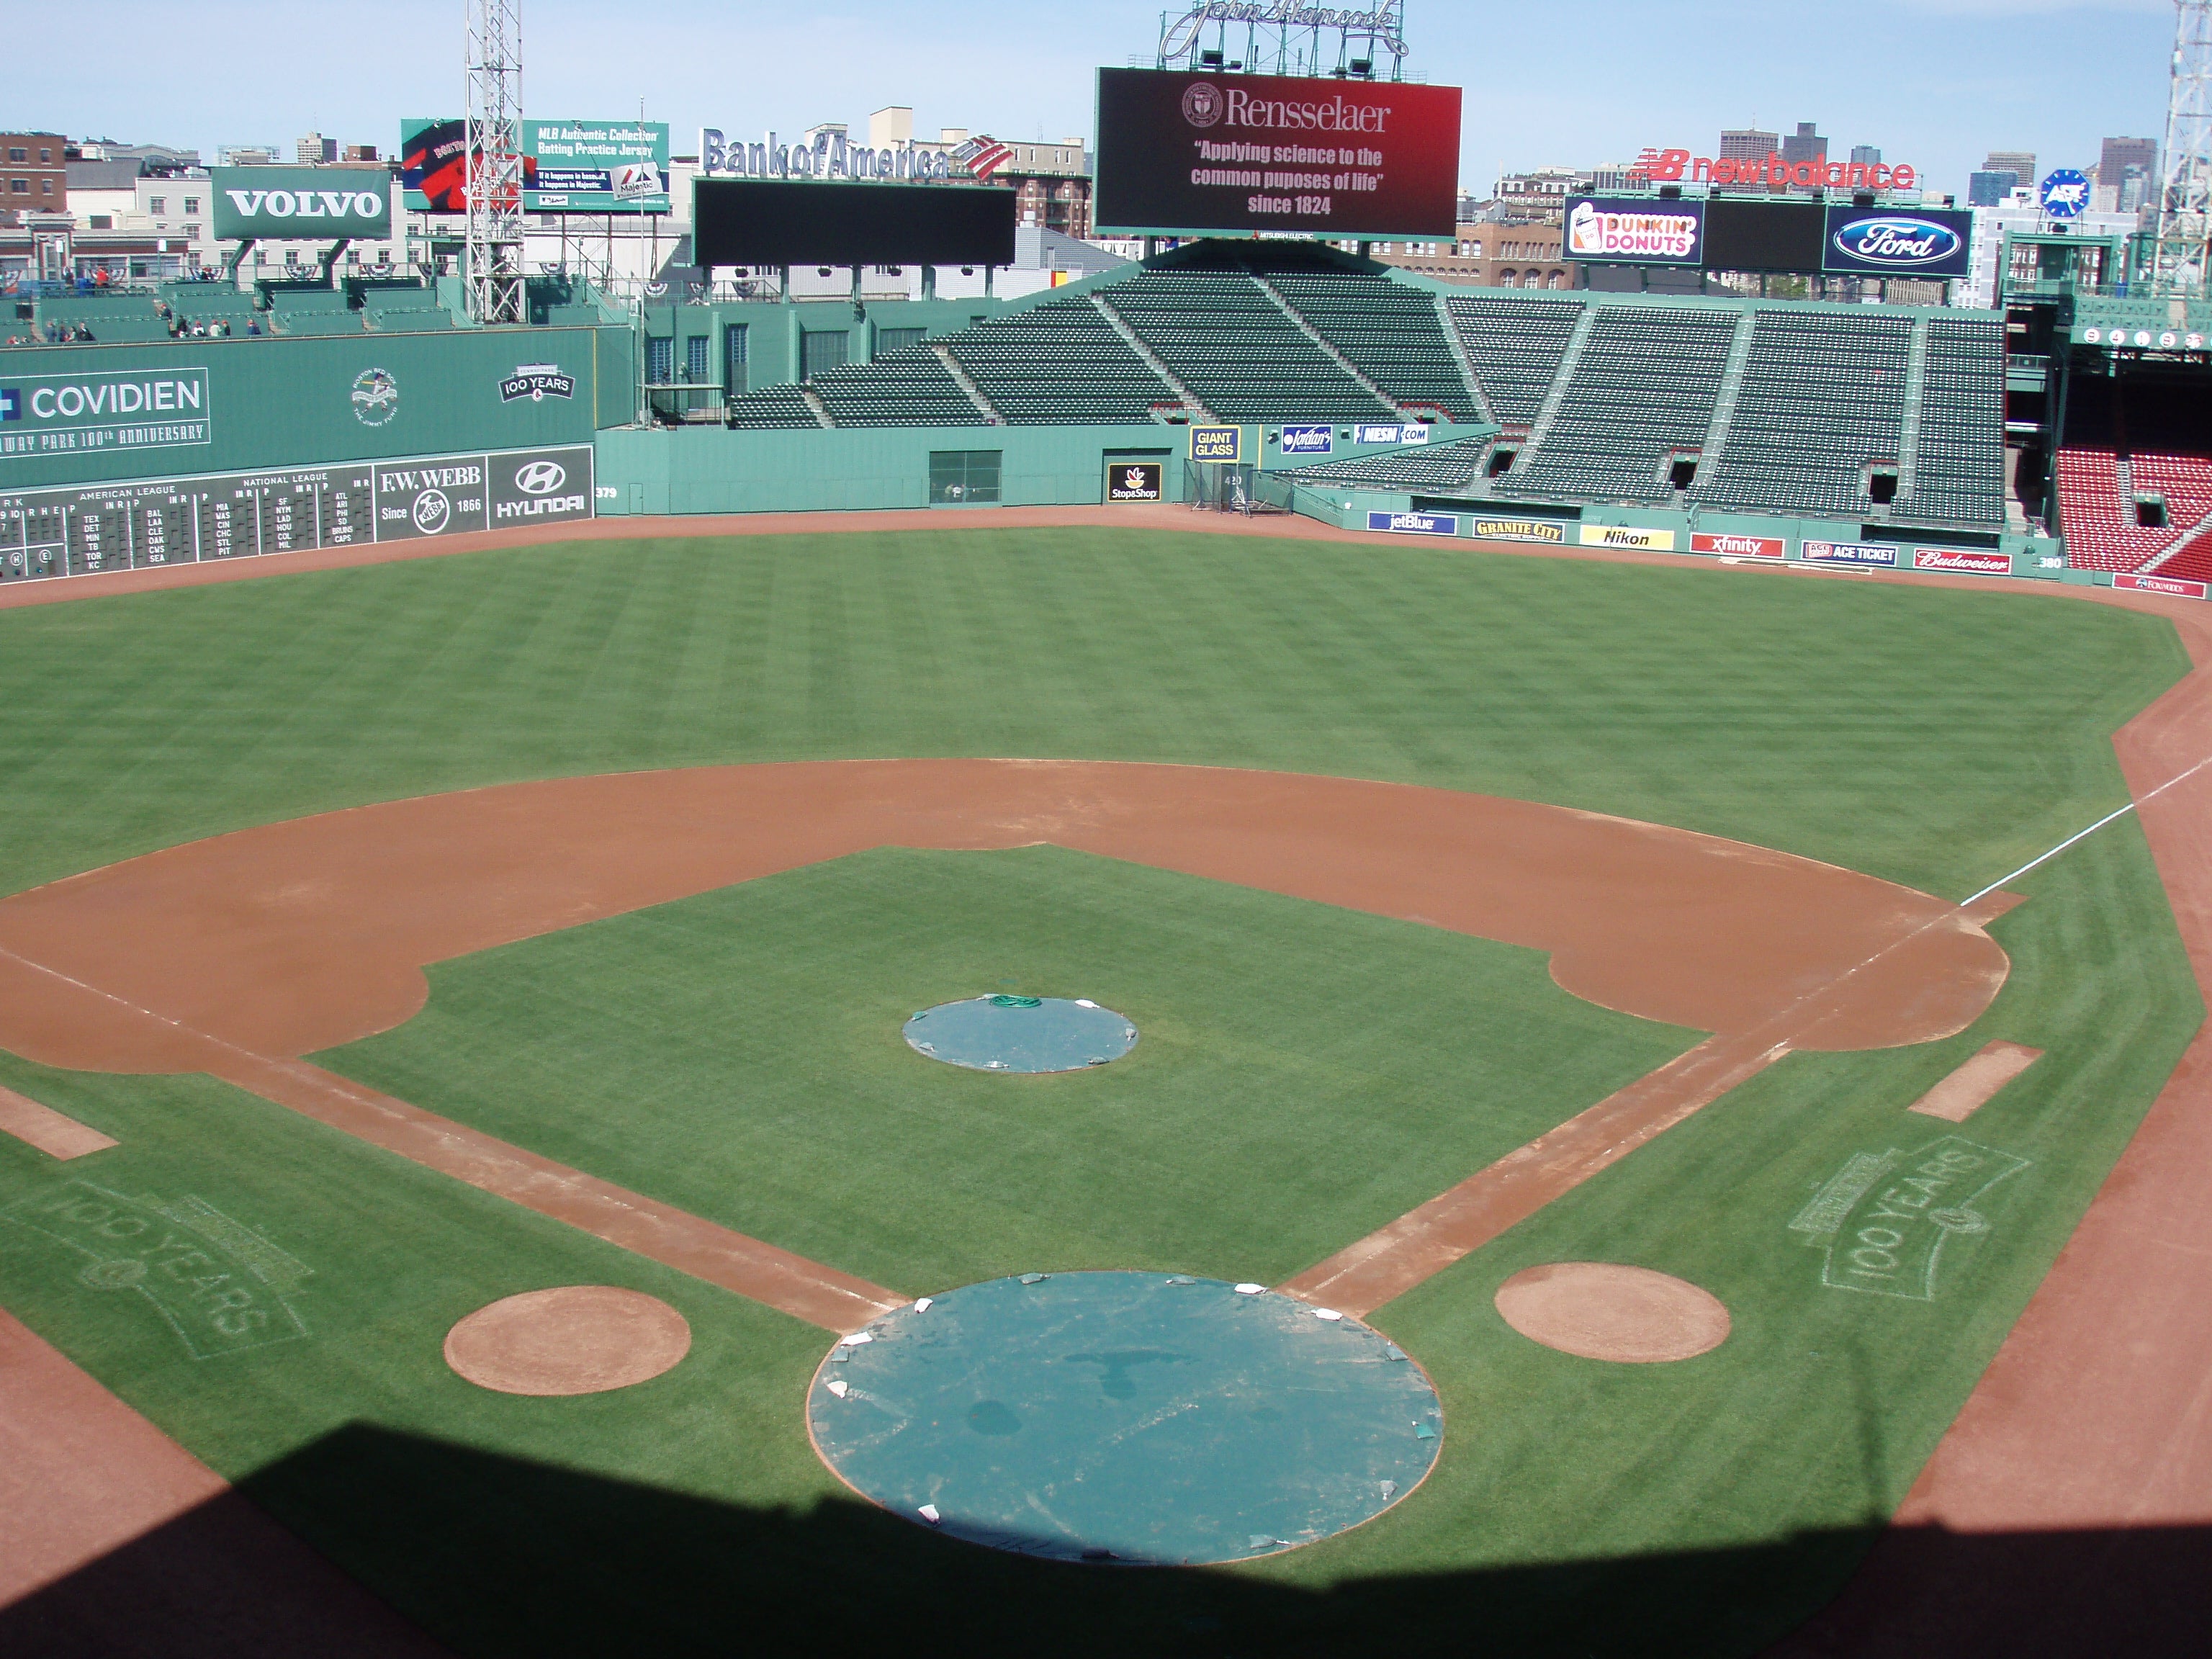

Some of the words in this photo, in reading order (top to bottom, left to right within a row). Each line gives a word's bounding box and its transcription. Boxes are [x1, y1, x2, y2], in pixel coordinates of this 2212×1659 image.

[1162, 0, 1262, 58] John
[1225, 89, 1391, 132] Rensselaer
[538, 127, 559, 140] MLB
[561, 127, 607, 140] Authentic
[609, 128, 657, 141] Collection
[538, 142, 573, 156] Batting
[576, 143, 616, 155] Practice
[619, 144, 652, 157] Jersey
[1274, 145, 1335, 164] science
[1339, 148, 1354, 165] to
[1357, 148, 1382, 166] the
[1191, 168, 1260, 186] common
[1264, 174, 1330, 190] puposes
[1334, 172, 1350, 191] of
[226, 190, 382, 218] VOLVO
[1248, 194, 1291, 213] since
[1294, 196, 1331, 215] 1824
[1607, 217, 1691, 235] DUNKIN'
[1606, 234, 1686, 252] DONUTS
[1858, 224, 1936, 256] Ford
[505, 379, 527, 395] 100
[529, 377, 569, 391] YEARS
[32, 380, 200, 418] COVIDIEN
[42, 433, 76, 450] PARK
[119, 424, 204, 444] ANNIVERSARY
[1197, 433, 1233, 444] GIANT
[1289, 426, 1331, 452] Jordan's
[1195, 444, 1233, 456] GLASS
[243, 476, 289, 486] NATIONAL
[292, 473, 328, 482] LEAGUE
[421, 467, 481, 488] WEBB
[1224, 476, 1241, 485] 420
[80, 490, 132, 500] AMERICAN
[138, 486, 176, 496] LEAGUE
[595, 487, 617, 498] 379
[1112, 488, 1156, 500] Stop&Shop
[106, 501, 114, 510] IN
[423, 503, 441, 519] WEBB
[457, 499, 481, 512] 1866
[497, 495, 585, 518] HYUNDAI
[147, 509, 162, 518] BAL
[382, 507, 408, 520] Since
[84, 524, 100, 533] DET
[1389, 514, 1434, 530] jetBlue
[86, 534, 100, 542] MIN
[1477, 522, 1532, 534] GRANITE
[1533, 523, 1562, 540] CITY
[1604, 531, 1650, 546] Nikon
[42, 552, 48, 561] E
[86, 552, 102, 561] TOR
[149, 554, 166, 562] SEA
[1833, 547, 1856, 559] ACE
[1858, 547, 1895, 561] TICKET
[1916, 551, 2008, 571] Budweiser
[89, 561, 100, 570] KC
[2039, 557, 2062, 569] 380
[1866, 1151, 1985, 1220] YEARS
[1848, 1227, 1902, 1279] 100
